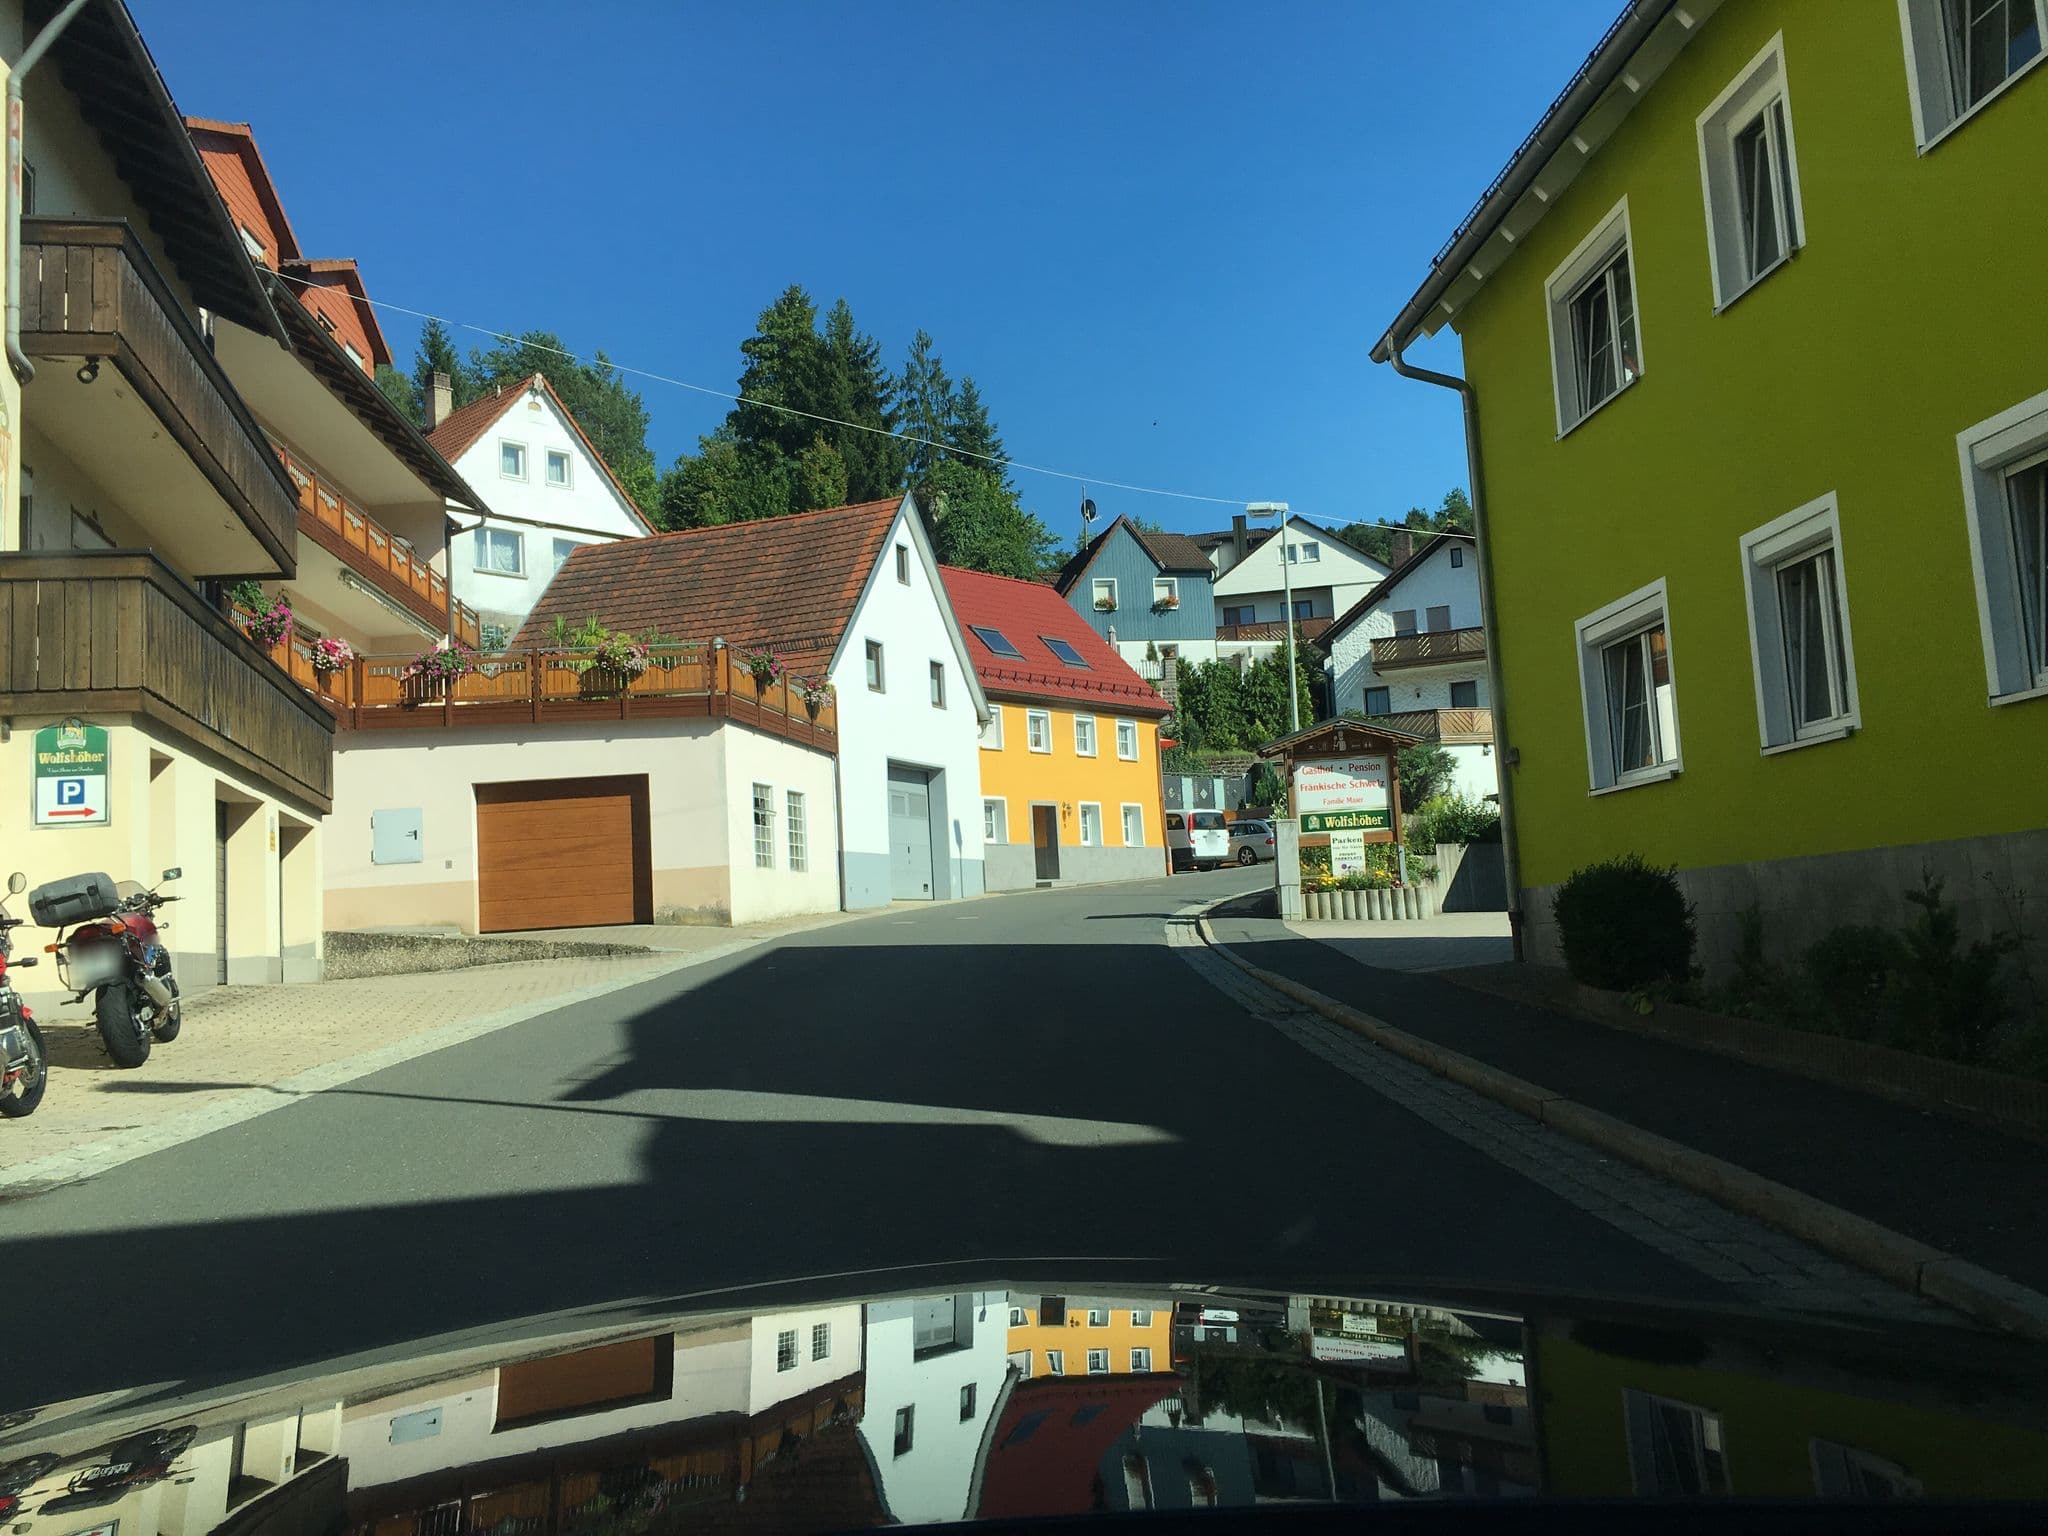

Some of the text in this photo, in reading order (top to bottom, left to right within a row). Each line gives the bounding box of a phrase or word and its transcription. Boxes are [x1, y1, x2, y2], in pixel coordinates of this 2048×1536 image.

[38, 750, 105, 765] Wolfshöher
[1302, 762, 1381, 775] Gasthof Pension
[62, 782, 81, 804] P
[1300, 779, 1385, 792] Fränkische Schweiz
[1324, 813, 1384, 828] Wolfshöher
